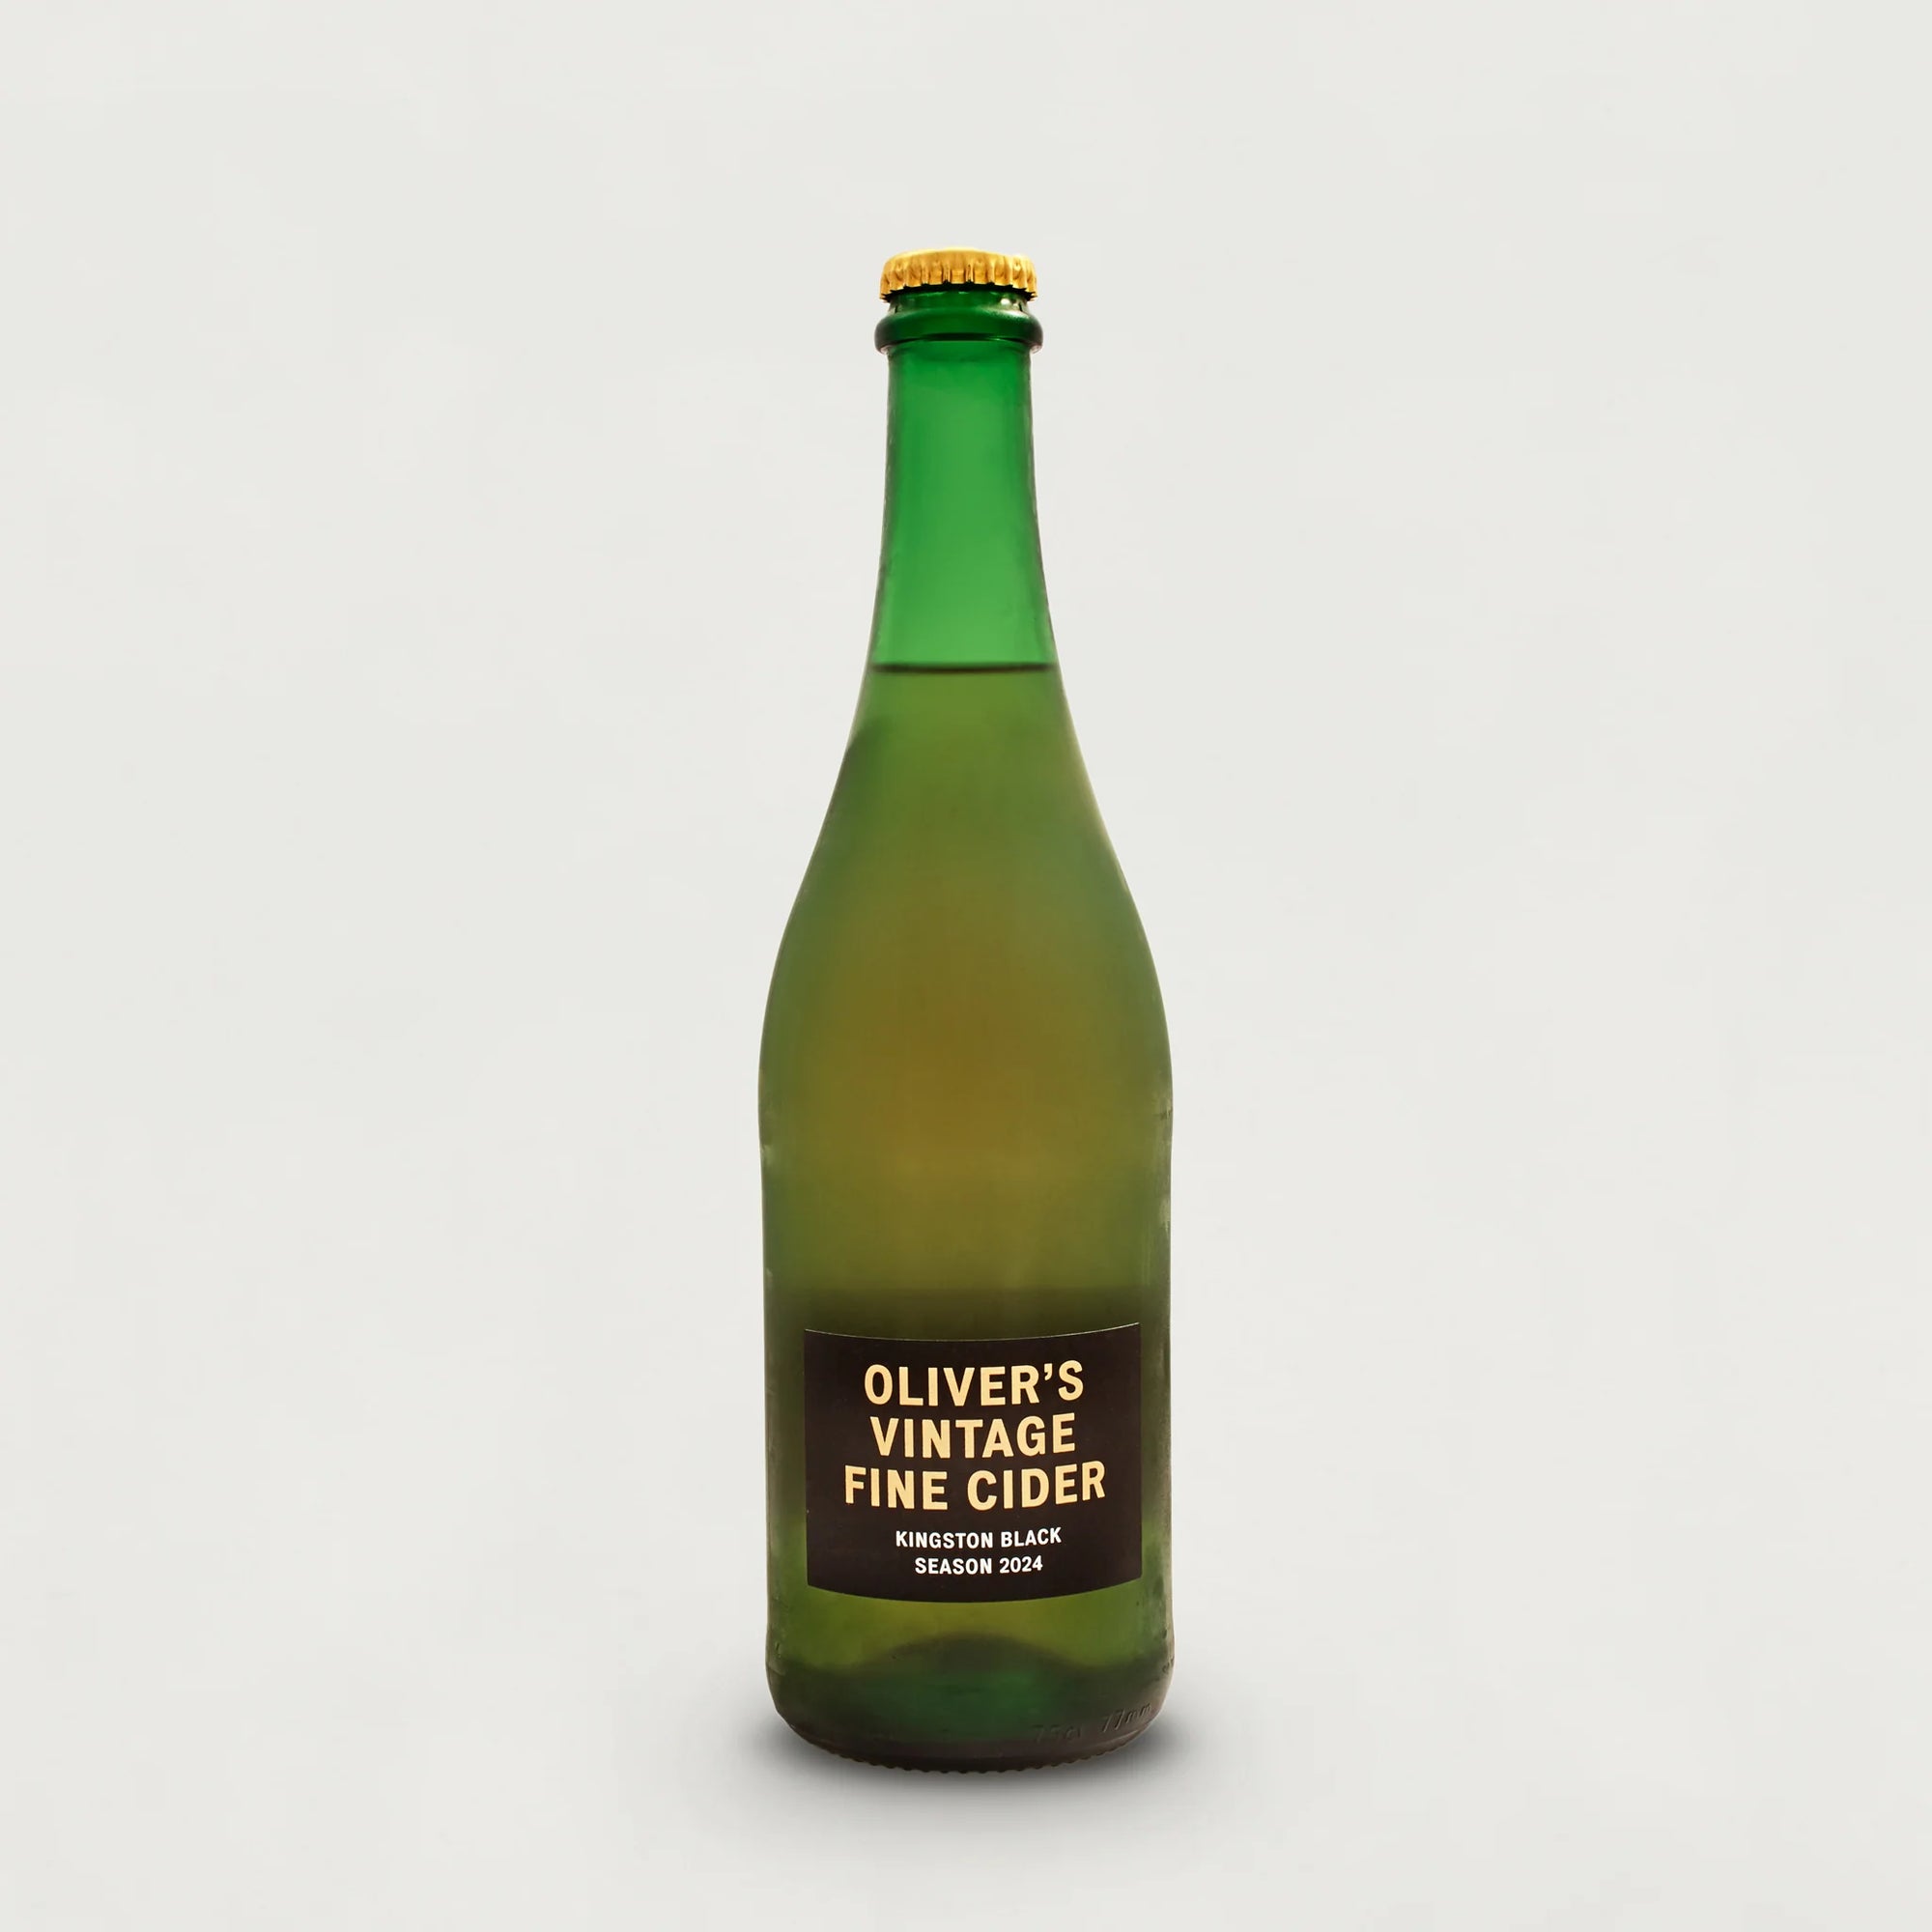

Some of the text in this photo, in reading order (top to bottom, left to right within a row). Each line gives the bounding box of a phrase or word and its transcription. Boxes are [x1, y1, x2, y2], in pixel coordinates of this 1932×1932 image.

[865, 1360, 1083, 1406] OLIVER’S
[870, 1412, 1075, 1458] VINTAGE
[845, 1461, 1105, 1510] FINE CIDER
[896, 1527, 1062, 1548] KINGSTON BLACK
[915, 1555, 1042, 1575] SEASON 2024
